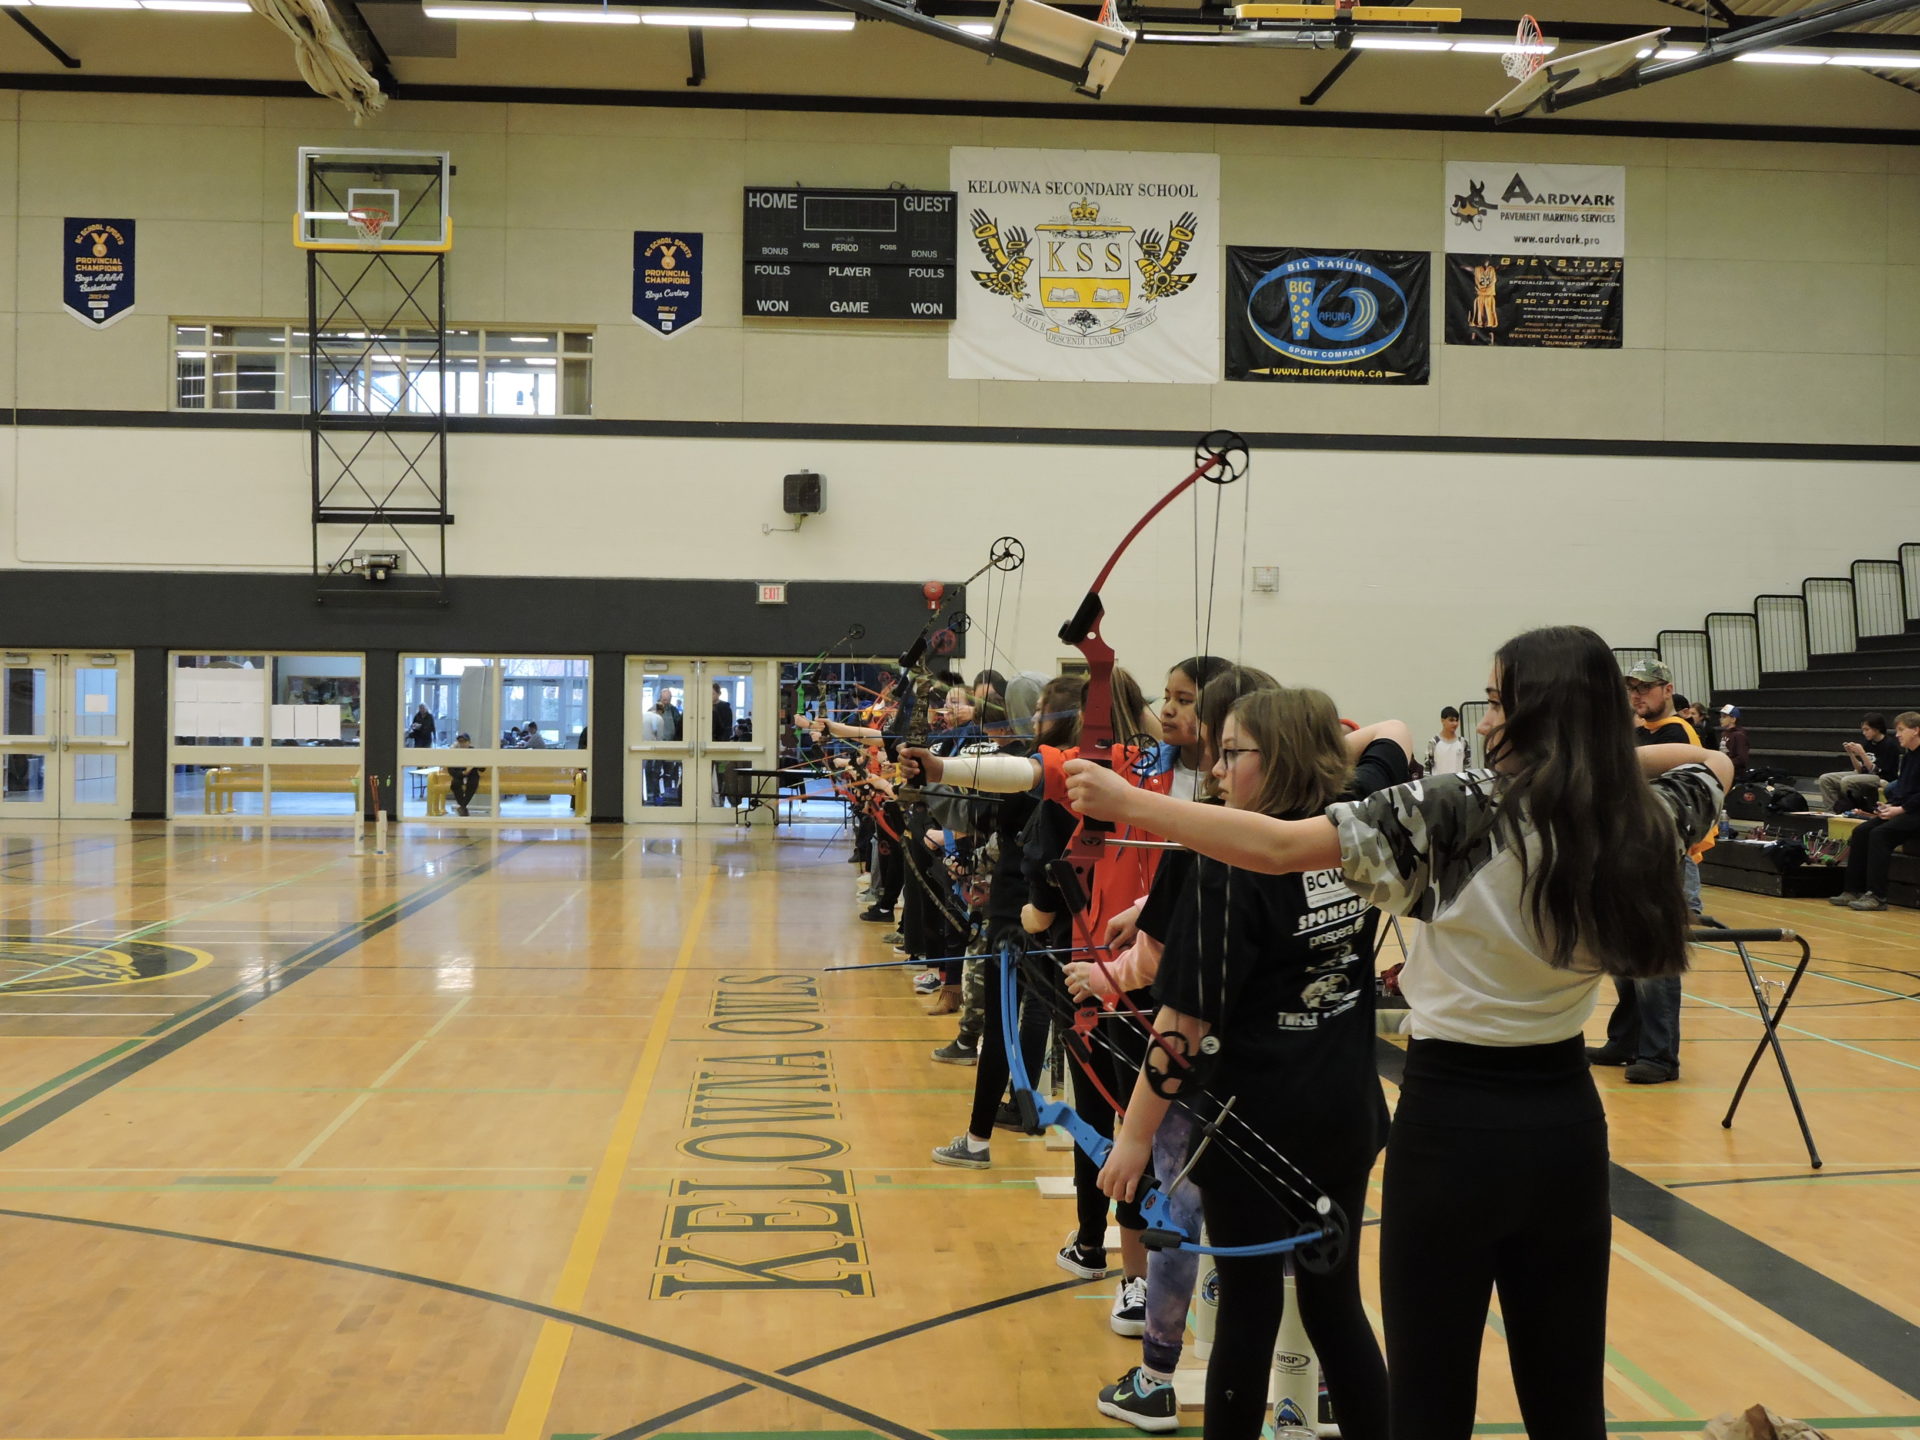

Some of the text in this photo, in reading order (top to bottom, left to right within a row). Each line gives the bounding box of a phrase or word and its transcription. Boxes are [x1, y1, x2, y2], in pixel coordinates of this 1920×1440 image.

[968, 180, 1198, 198] KELOWNA SECONDARY SCHOOL
[749, 193, 797, 208] HOME
[903, 196, 951, 212] GUEST
[1501, 213, 1615, 223] PAVEMENT MARKING SERVICES
[1514, 234, 1600, 246] www.aardvark.pro
[762, 247, 788, 255] BONUS
[832, 244, 858, 252] PERIOD
[754, 265, 790, 275] FOULS
[829, 267, 871, 276] PLAYER
[908, 268, 944, 278] FOULS
[1288, 260, 1372, 275] BIG KAHUNA
[1289, 281, 1312, 293] BIG
[645, 289, 689, 300] Boys Curling
[756, 300, 789, 311] WON
[830, 301, 870, 313] GAME
[911, 303, 943, 314] WON
[1017, 311, 1046, 331] AMOR
[1288, 346, 1366, 358] SPORT COMPANY
[1272, 368, 1383, 378] WWW.BIGKAHUNA.CA
[764, 587, 780, 600] EXIT
[1309, 925, 1353, 949] prospera
[650, 974, 875, 1300] KELOWNA OWLS
